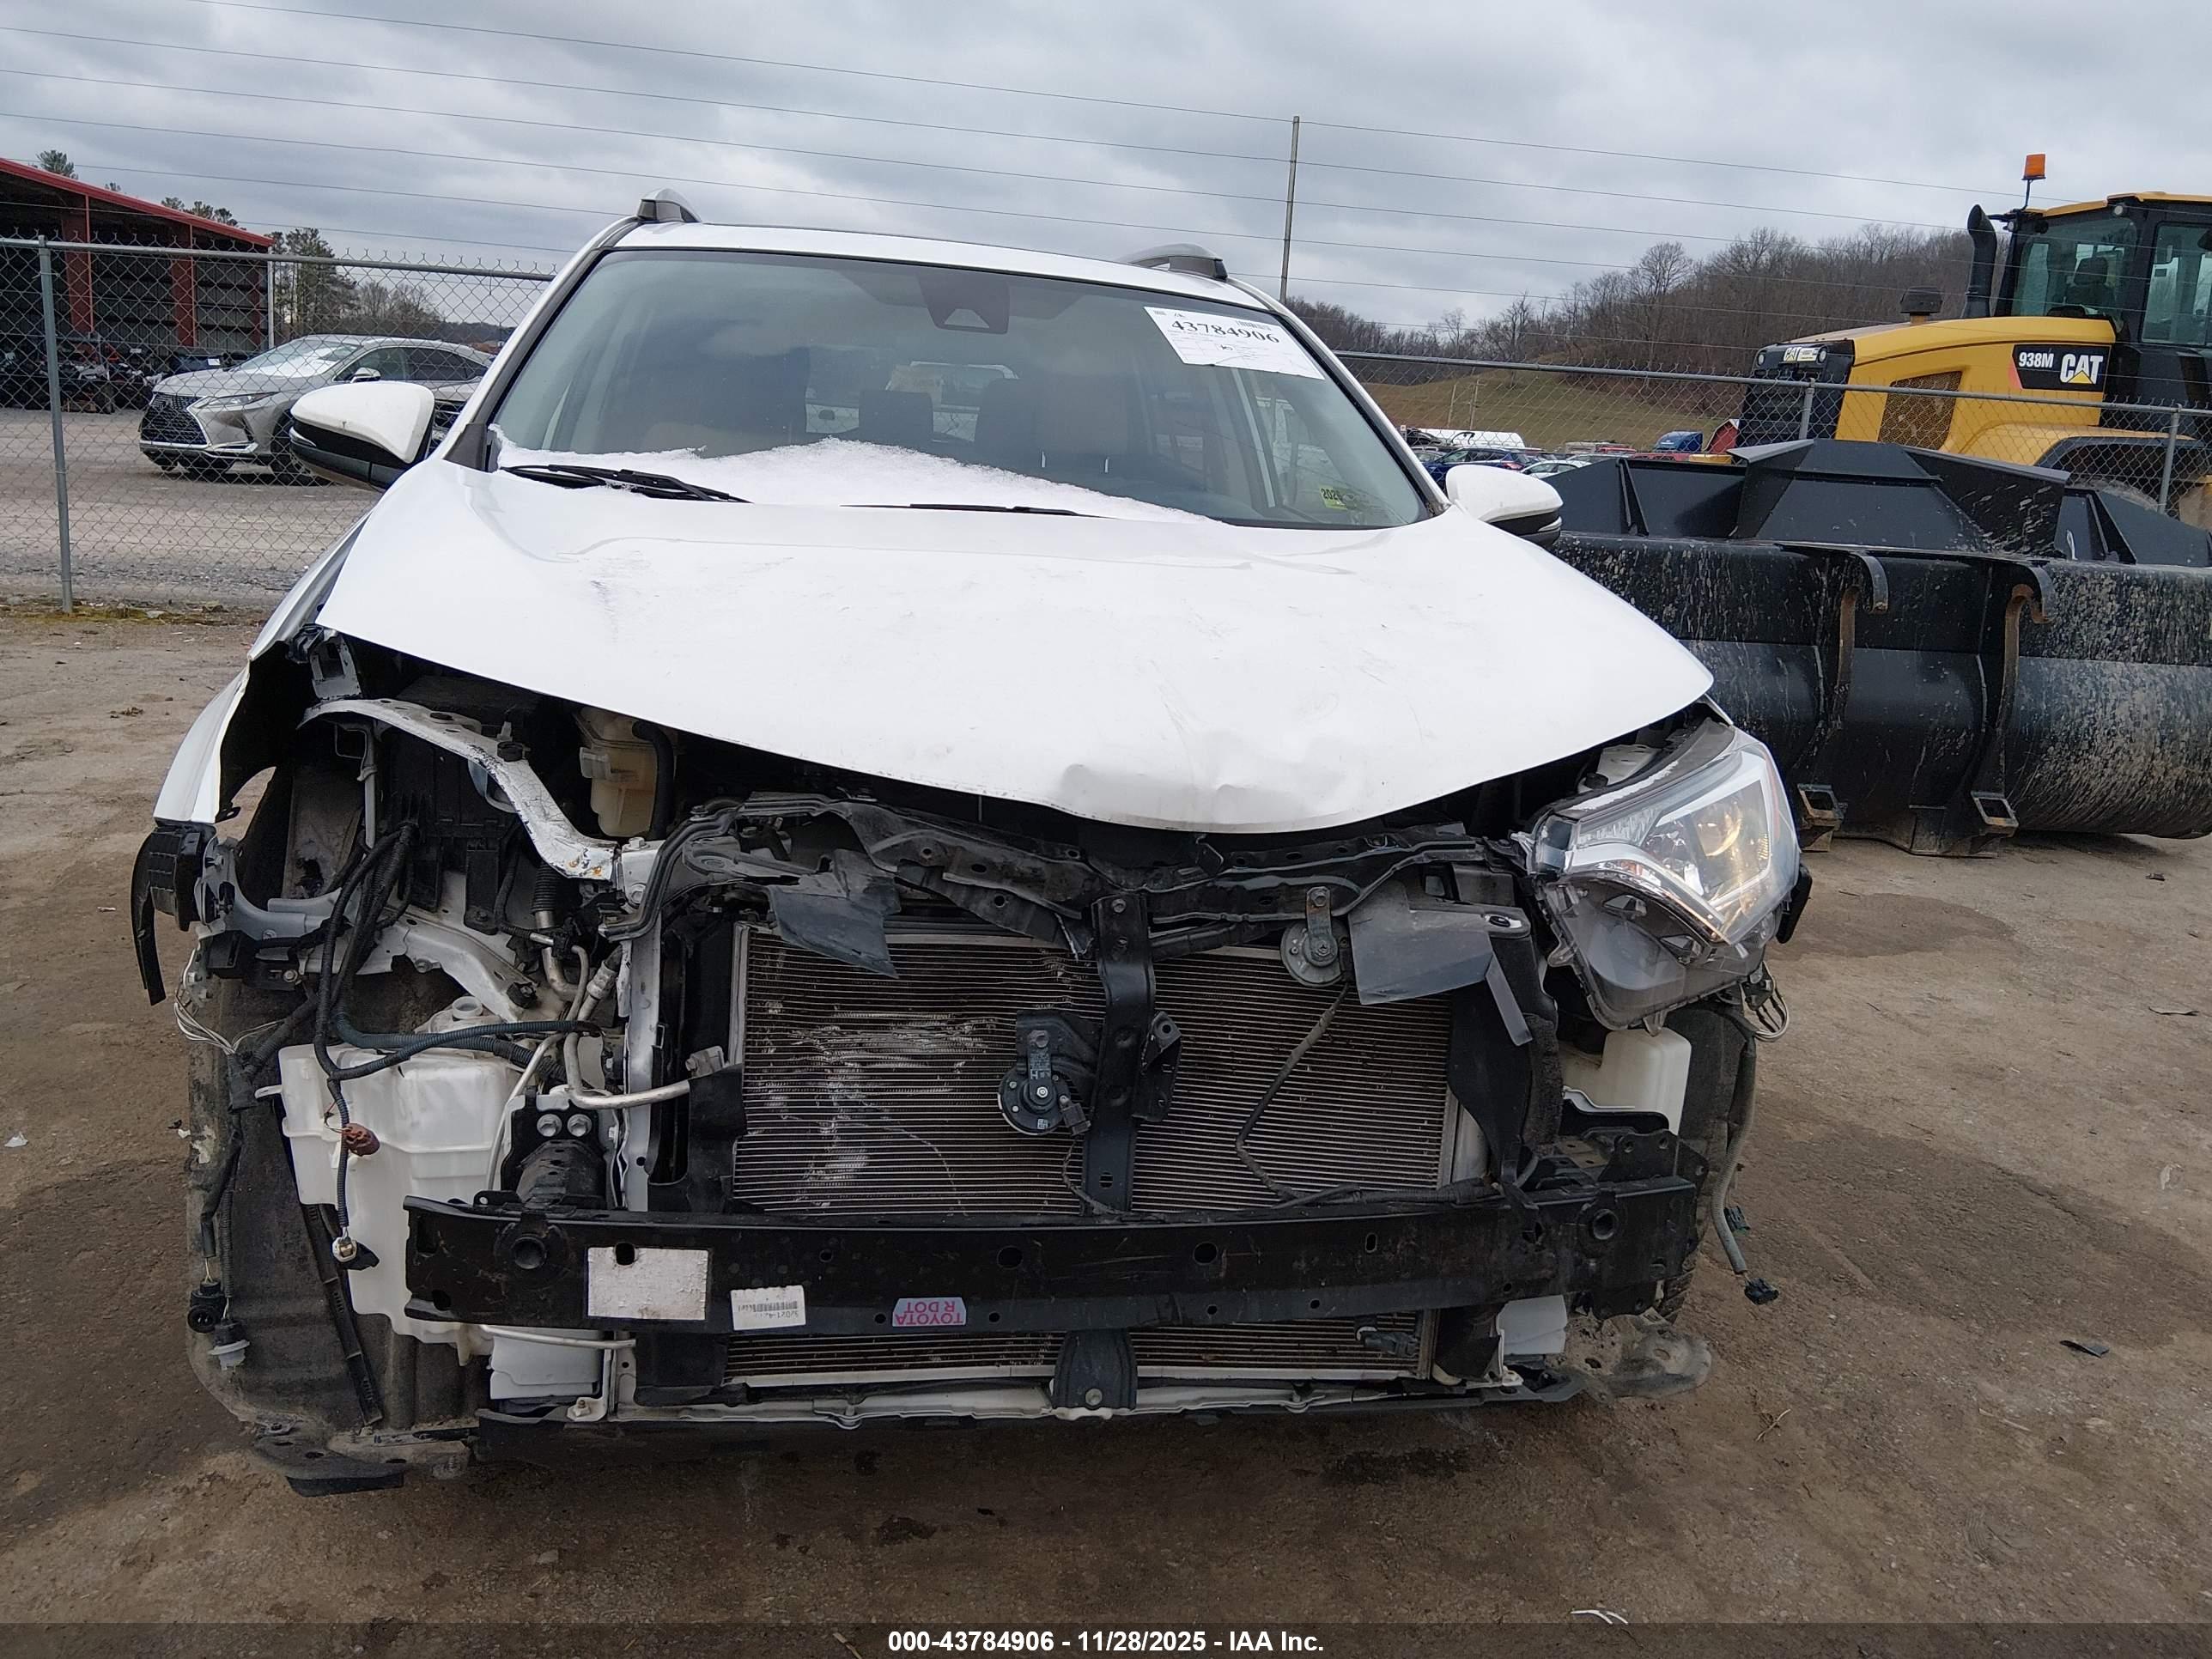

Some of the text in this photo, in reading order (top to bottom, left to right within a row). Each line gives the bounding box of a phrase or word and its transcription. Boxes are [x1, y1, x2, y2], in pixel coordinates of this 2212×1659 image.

[1171, 320, 1279, 343] 43784906
[1783, 346, 1802, 362] CAT
[2019, 352, 2054, 368] 938M
[2060, 353, 2103, 384] CAT
[895, 1313, 963, 1325] TOYOTA
